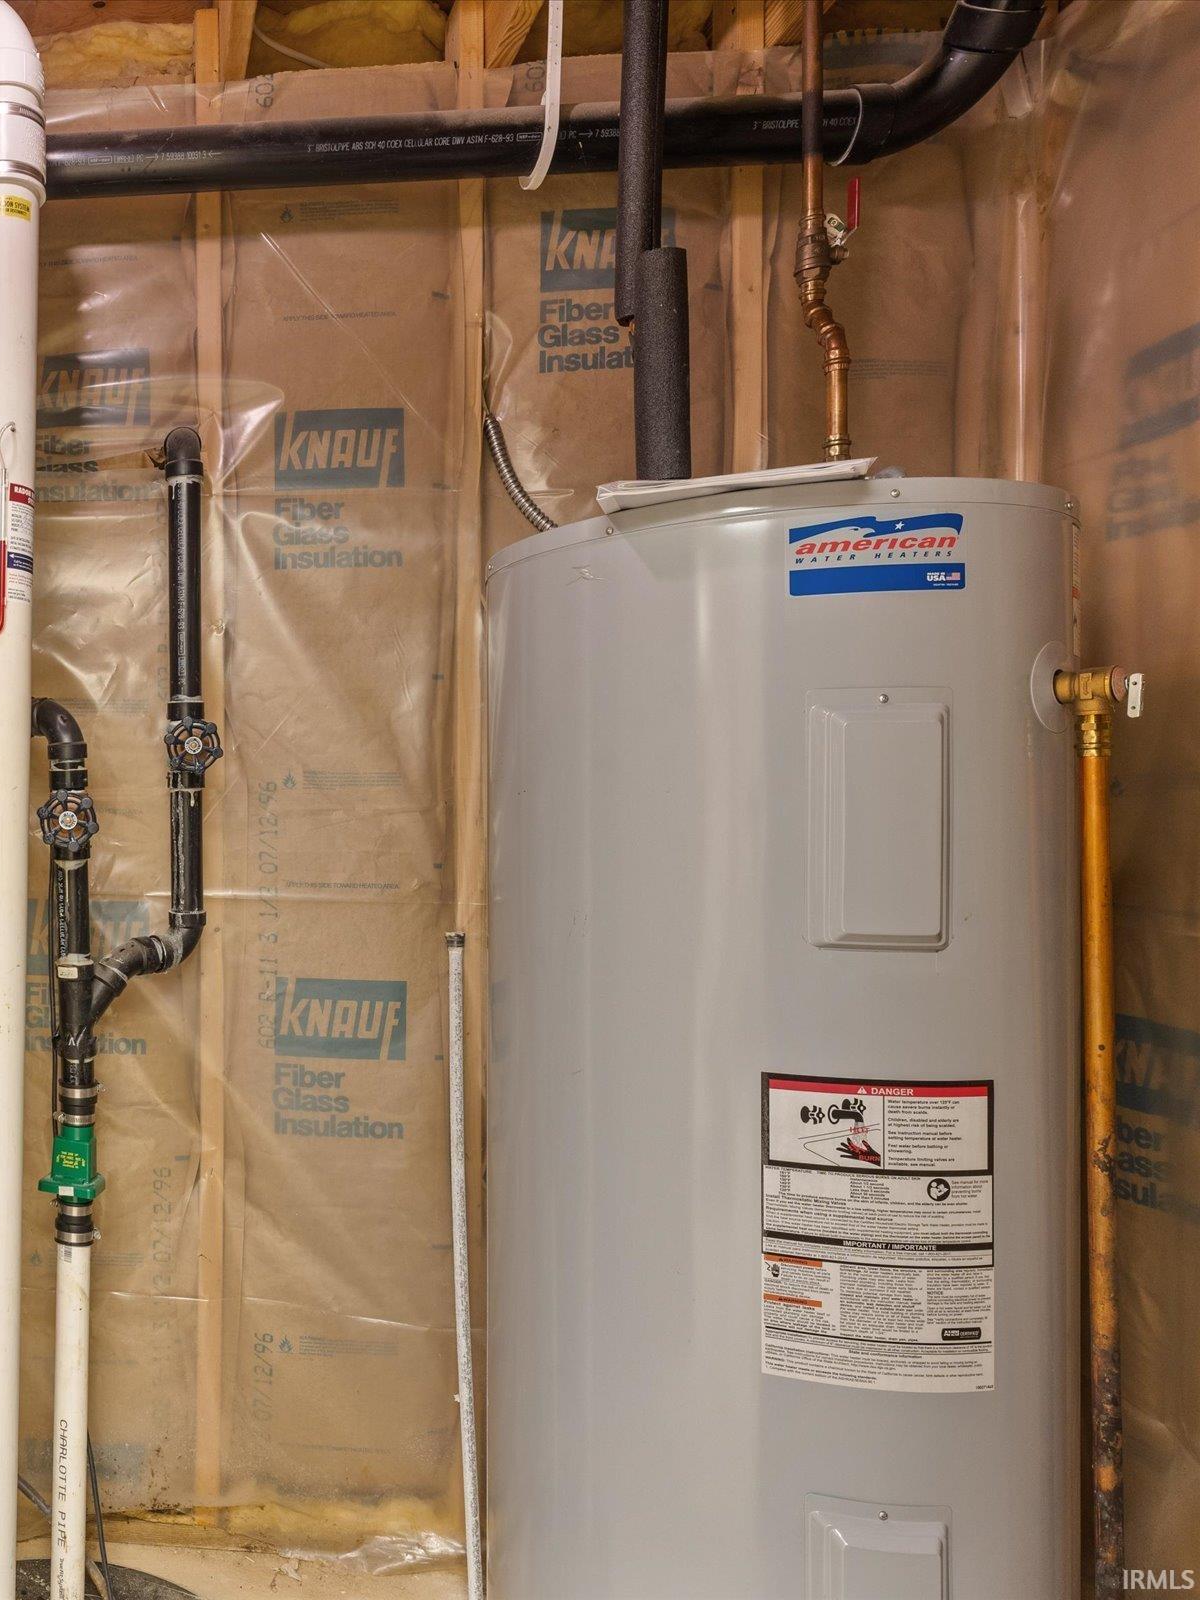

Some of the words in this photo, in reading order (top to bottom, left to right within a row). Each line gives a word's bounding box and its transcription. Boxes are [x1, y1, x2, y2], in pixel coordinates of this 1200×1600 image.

[351, 141, 363, 150] ABS
[377, 140, 386, 149] 40
[434, 137, 451, 146] CORE
[540, 299, 614, 324] Fiber
[537, 324, 620, 348] Glass
[539, 346, 636, 374] Insulat
[278, 410, 400, 488] KNAUF
[36, 480, 153, 503] nsulation
[275, 497, 345, 521] Fiber
[272, 522, 350, 546] Glass
[795, 534, 956, 556] american
[274, 546, 403, 571] Insulation
[795, 554, 856, 564] WATER
[874, 550, 953, 559] HEATERS
[278, 977, 402, 1060] KNAUF
[25, 1033, 147, 1055] Instion
[275, 1063, 346, 1089] Fiber
[272, 1087, 350, 1113] Glass
[871, 1087, 914, 1096] DANGER
[274, 1111, 404, 1140] Insulation
[1116, 1121, 1162, 1150] ber
[843, 1240, 887, 1250] IMPORTANT
[58, 1419, 68, 1502] CHARLOTTE
[57, 1510, 66, 1547] PIPE
